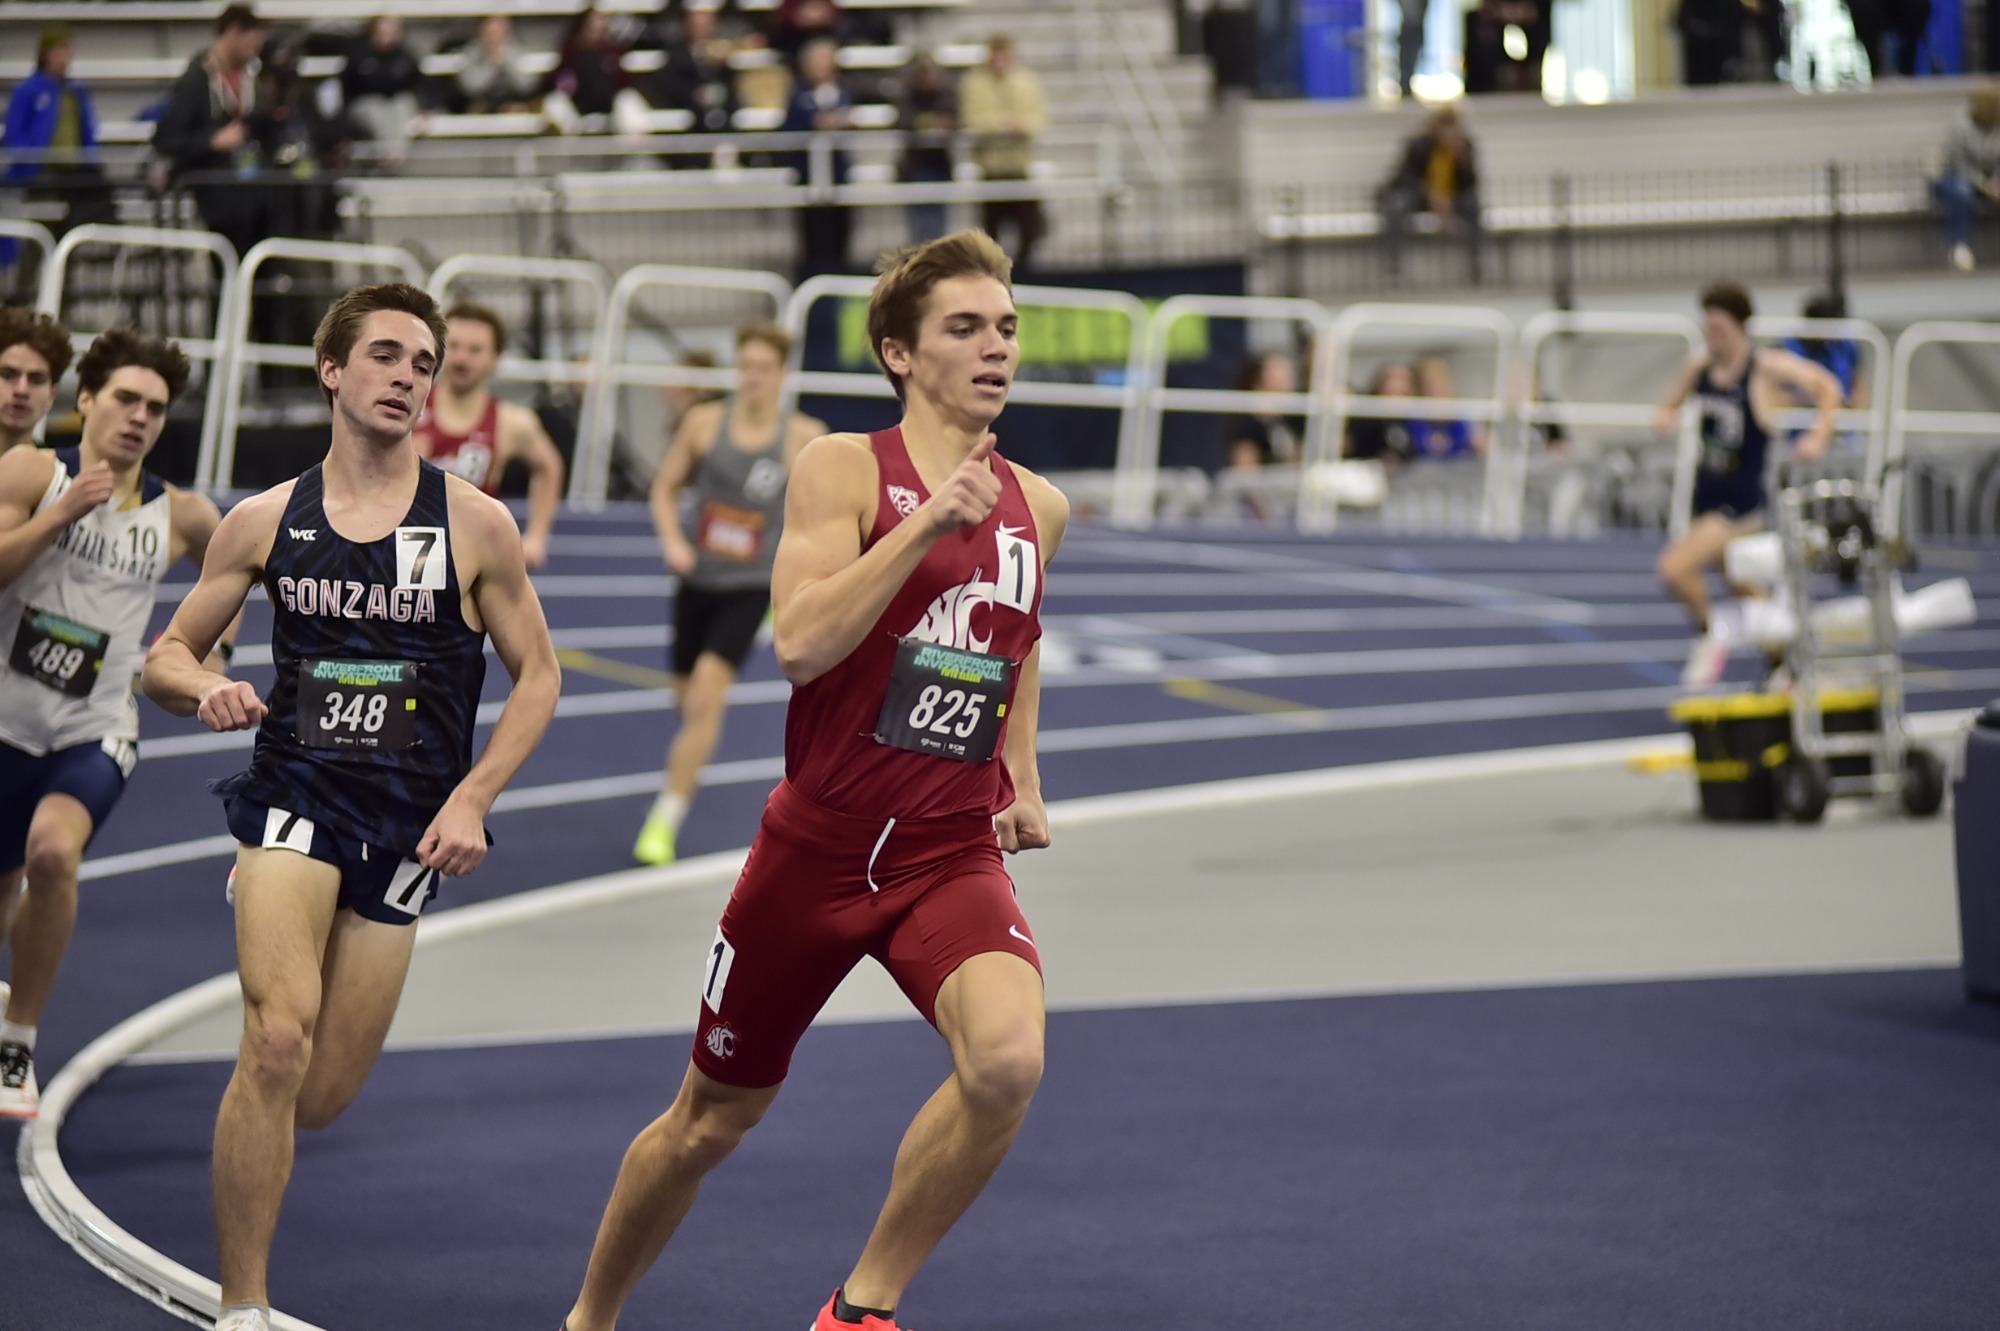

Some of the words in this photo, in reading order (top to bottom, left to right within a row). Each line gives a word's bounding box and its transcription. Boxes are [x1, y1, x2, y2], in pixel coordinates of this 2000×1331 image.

[128, 525, 157, 558] 10
[288, 527, 318, 542] WCC
[402, 532, 437, 585] 7
[1008, 541, 1024, 605] 1
[277, 576, 436, 623] GONZAGA
[28, 638, 86, 681] 489
[313, 668, 403, 682] INVITATIONAL
[318, 661, 403, 674] RIVERFRONT
[913, 654, 1003, 682] INVITATIONAL
[920, 647, 1005, 671] RIVERFRONT
[319, 691, 388, 733] 348
[908, 684, 987, 738] 825
[706, 941, 726, 1000] 1
